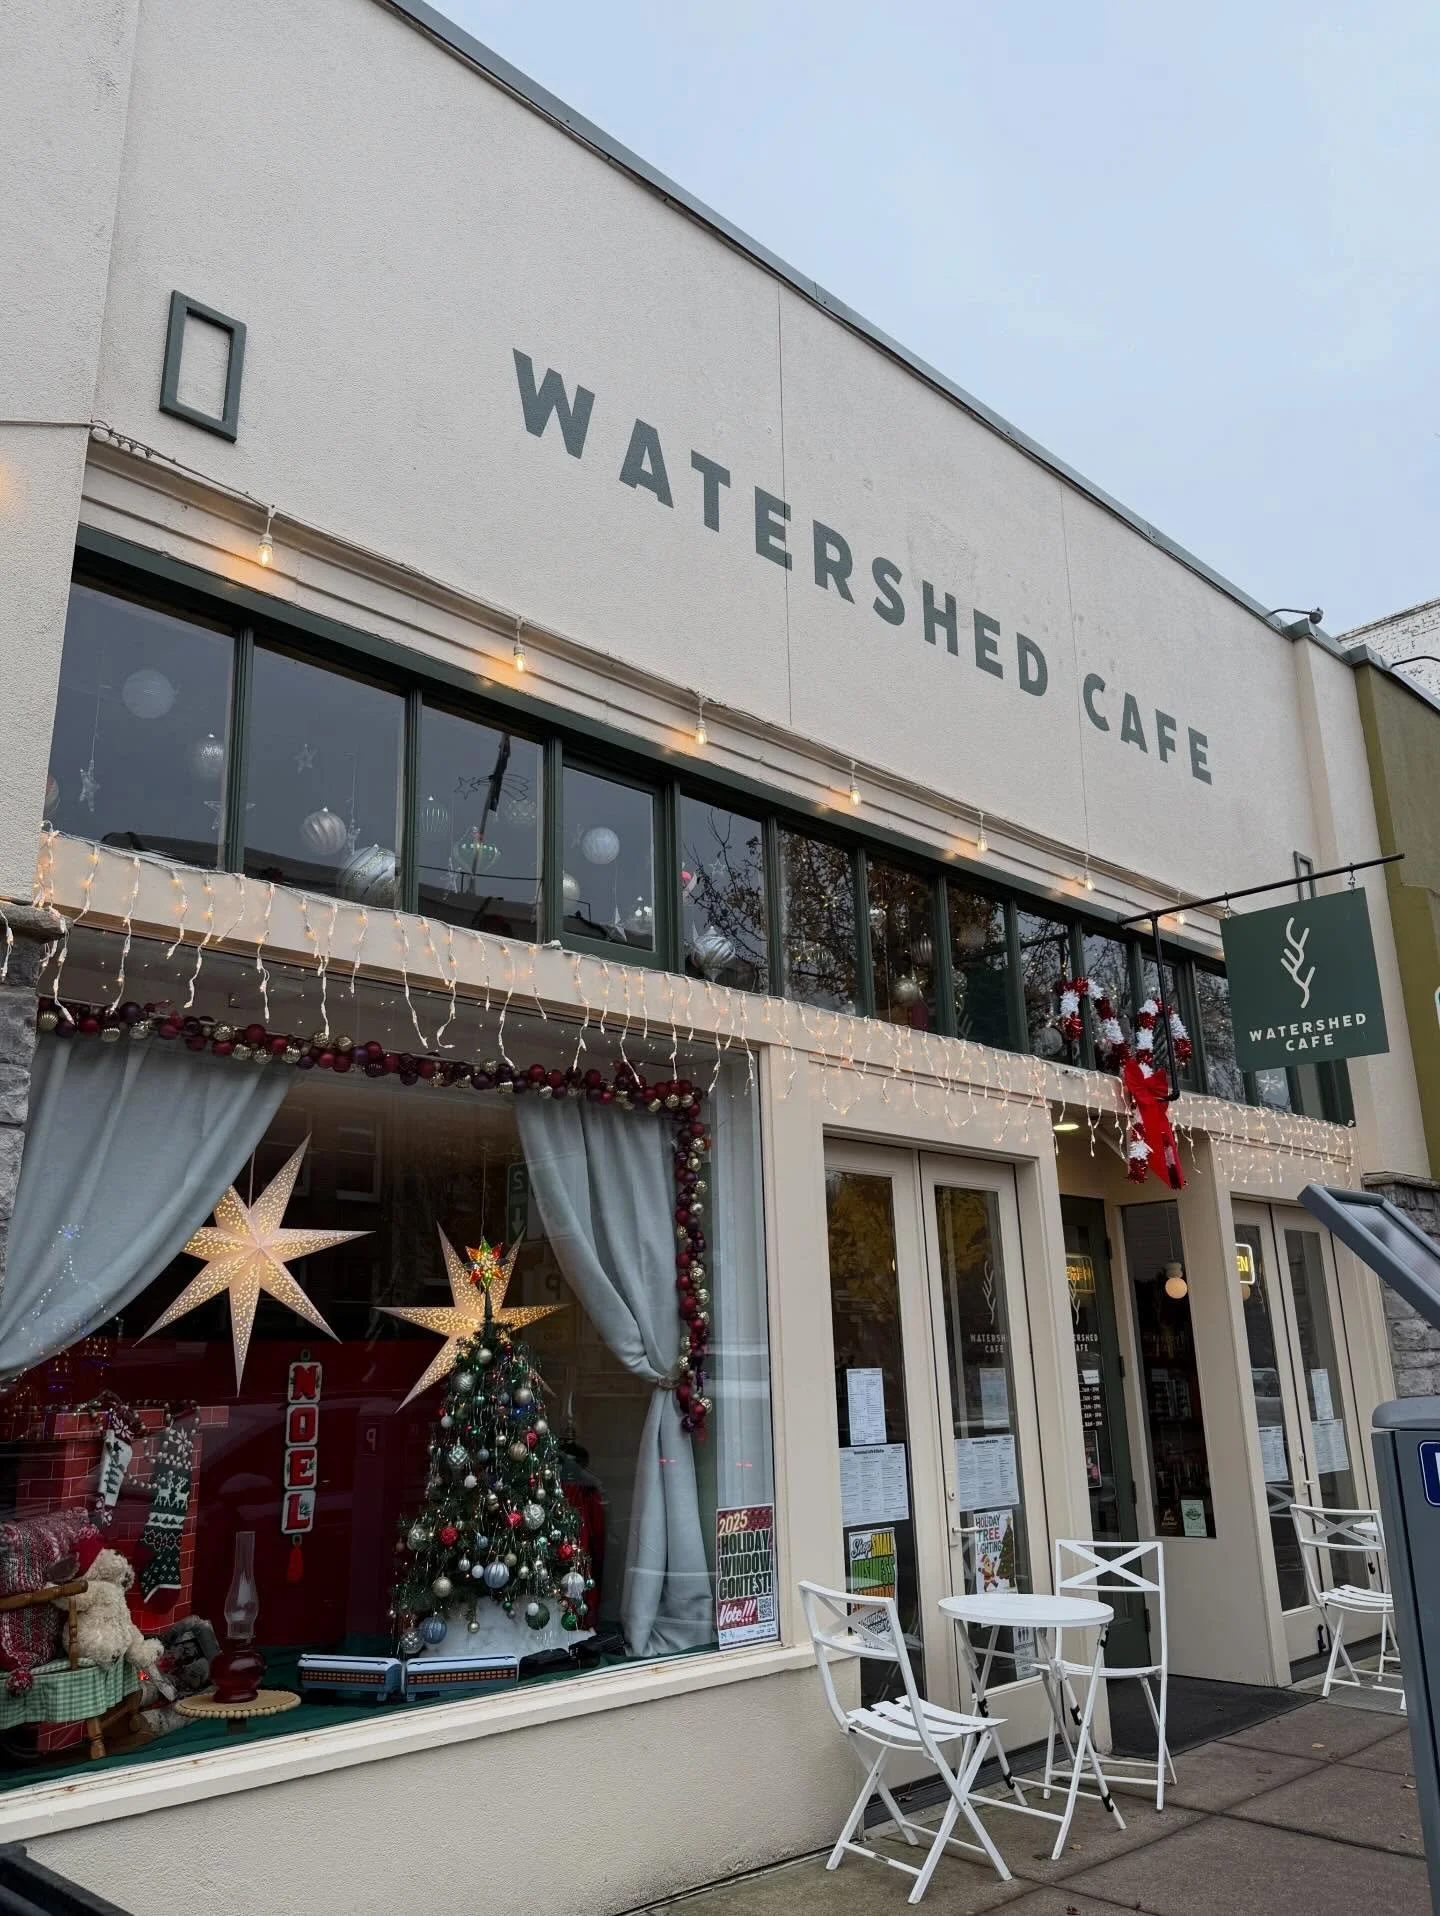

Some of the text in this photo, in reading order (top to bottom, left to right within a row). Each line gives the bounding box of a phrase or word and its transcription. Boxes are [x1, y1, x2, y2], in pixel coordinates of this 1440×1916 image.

[512, 347, 1212, 785] WATERSHED CAFE
[1249, 1013, 1367, 1042] WATERSHED
[1285, 1033, 1334, 1052] CAFE
[1236, 1255, 1249, 1272] EN
[970, 1333, 1006, 1343] WATERSH
[984, 1344, 1004, 1353] CAFE
[1073, 1333, 1098, 1342] ERSHED
[1075, 1343, 1089, 1352] AFE
[285, 1365, 318, 1531] NOEL
[719, 1510, 748, 1536] 2025
[976, 1514, 1000, 1528] HOLIDAY
[721, 1528, 770, 1556] HOLIDAY
[851, 1532, 894, 1559] Shop SMALL
[976, 1527, 1000, 1542] TREE
[720, 1550, 771, 1578] WINDOW
[852, 1557, 896, 1590] BUSINESS
[719, 1571, 772, 1601] CONTEST!
[719, 1599, 757, 1627] Vote!!!
